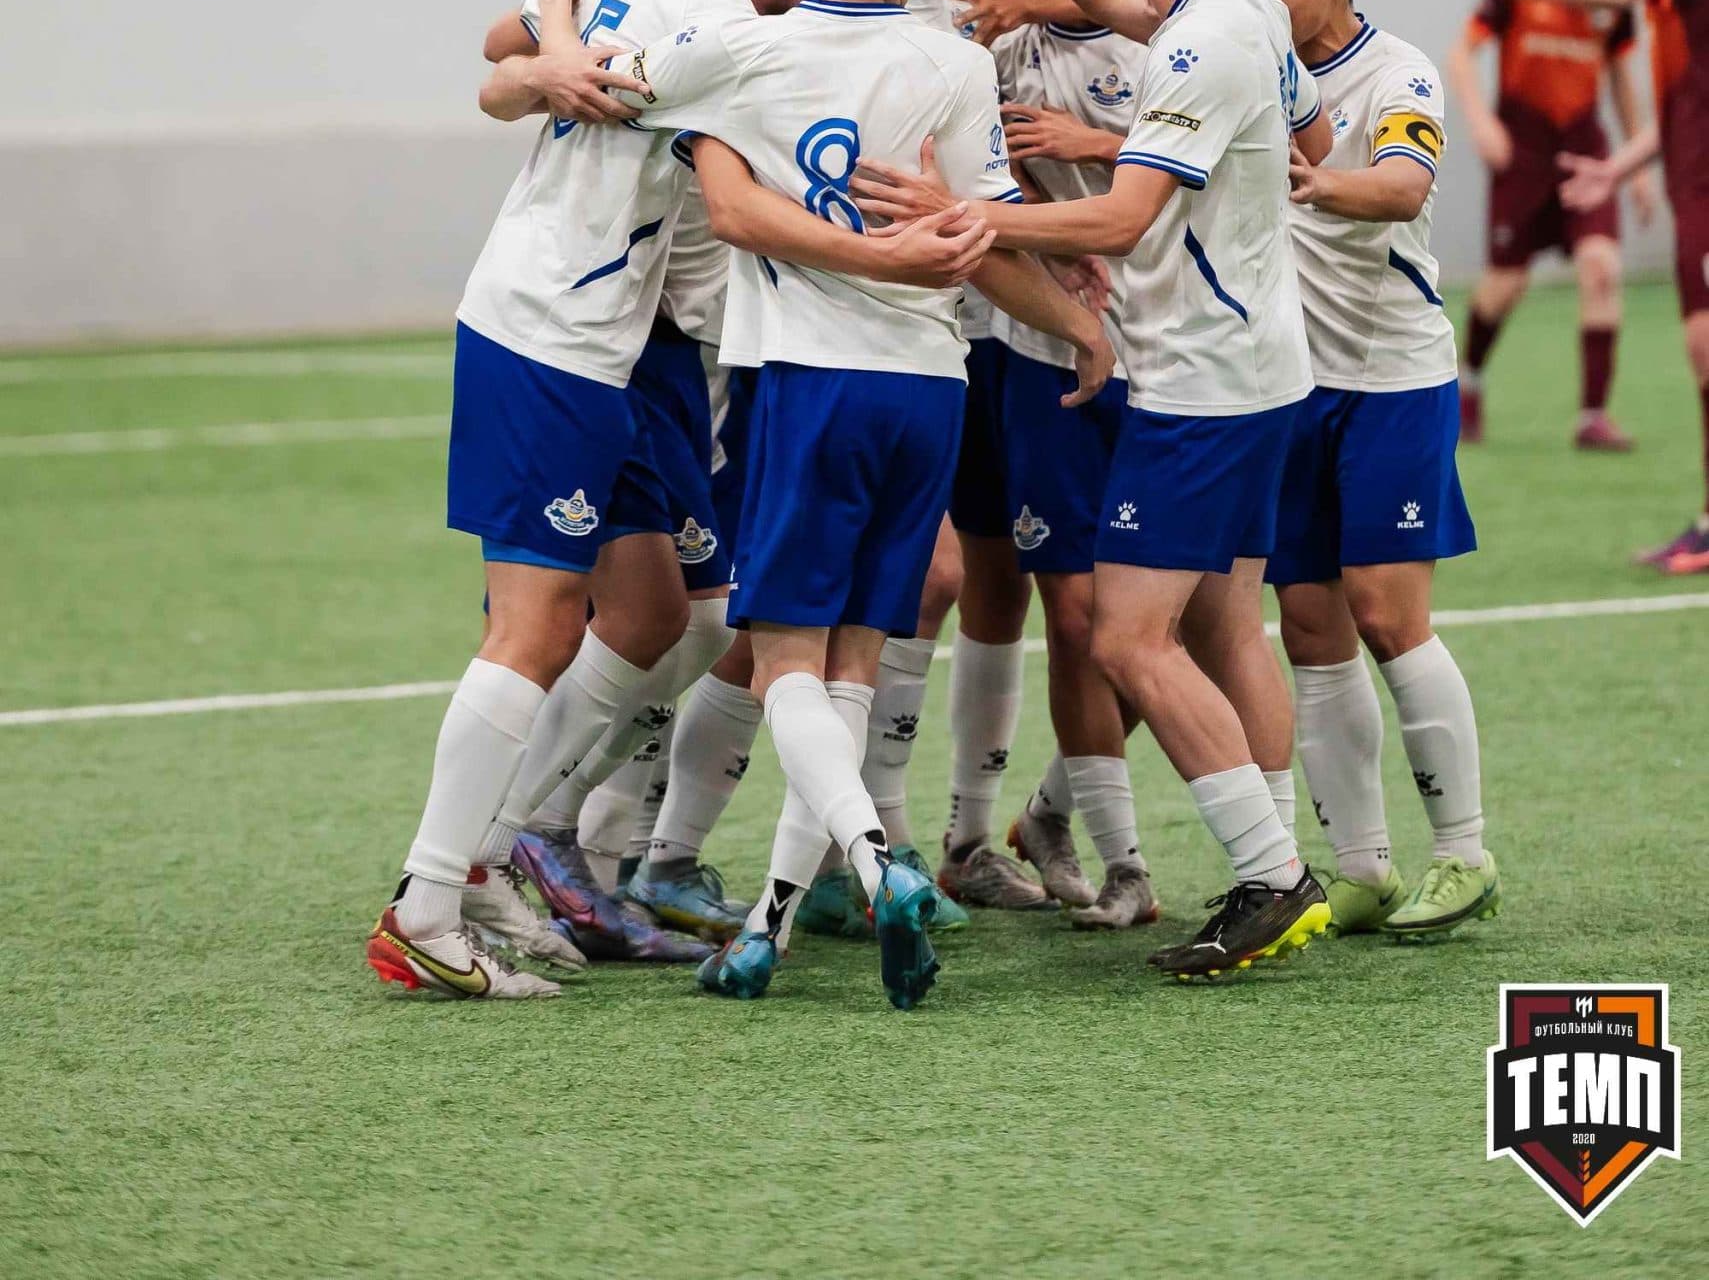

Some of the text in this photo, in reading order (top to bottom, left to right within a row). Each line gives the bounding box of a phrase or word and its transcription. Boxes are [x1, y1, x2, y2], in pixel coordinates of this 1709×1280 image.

[796, 117, 864, 234] 8
[1110, 520, 1140, 530] KELME
[1397, 520, 1424, 529] KELME
